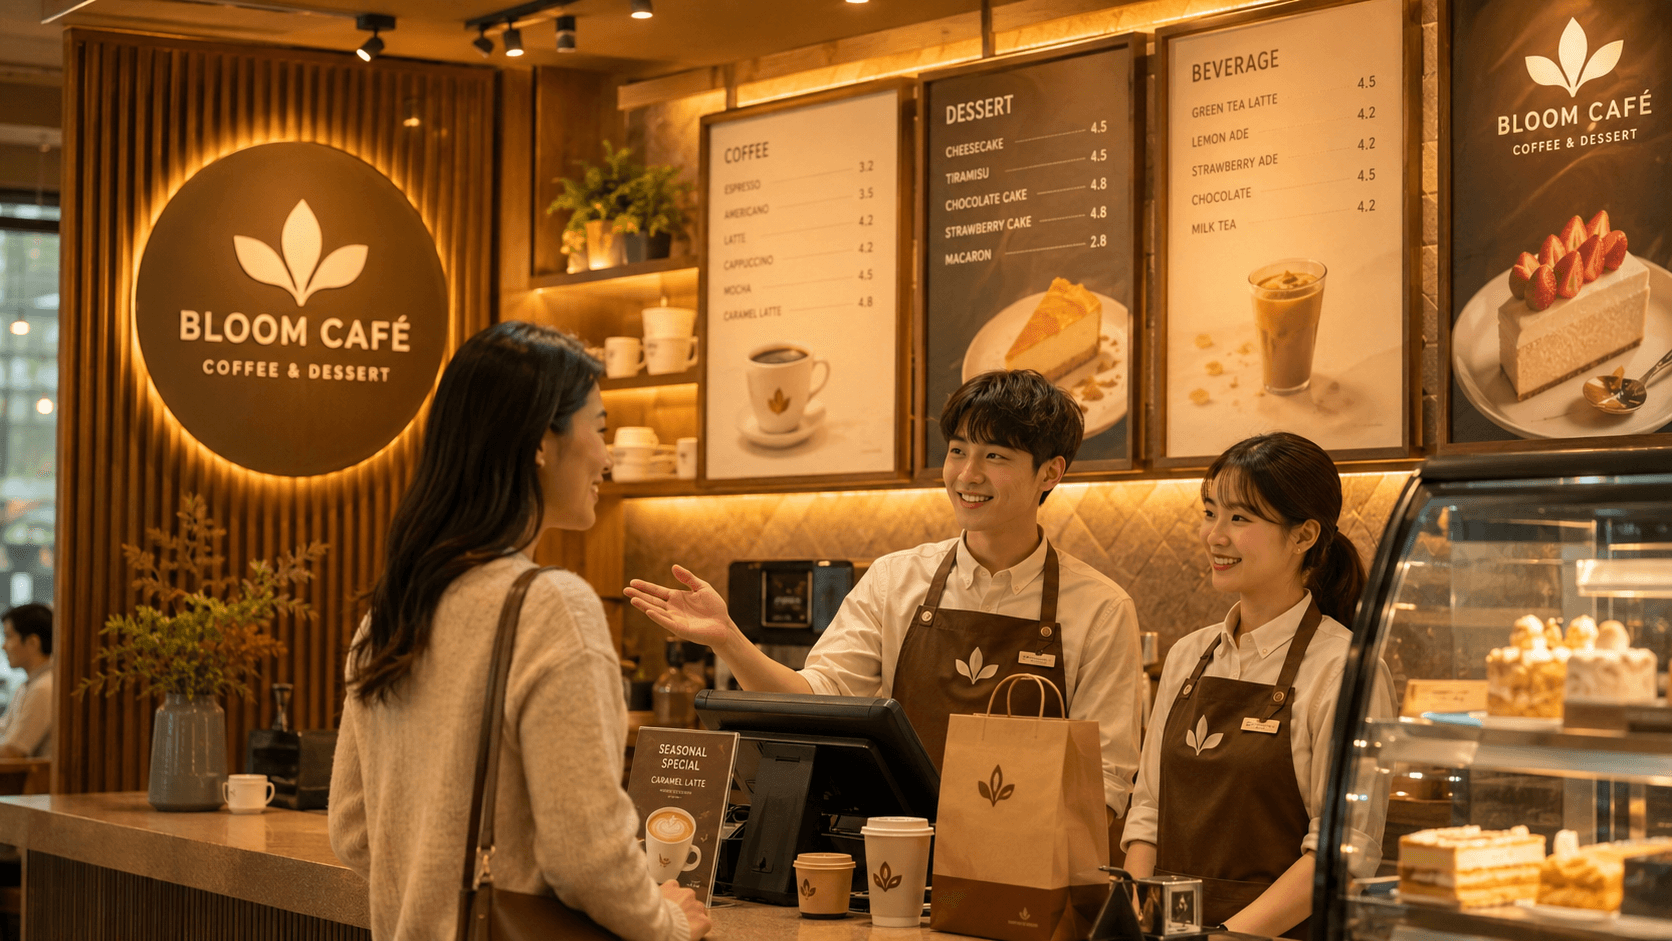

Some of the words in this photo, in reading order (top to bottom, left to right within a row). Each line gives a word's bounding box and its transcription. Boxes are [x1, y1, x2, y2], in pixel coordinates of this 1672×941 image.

[1192, 48, 1280, 82] BEVERAGE
[946, 94, 1014, 125] DESSERT
[1192, 103, 1224, 118] GREEN
[1227, 100, 1245, 112] TEA
[1248, 93, 1278, 109] LATTE
[1357, 75, 1376, 89] 4.5
[1498, 104, 1578, 136] BLOOM
[1588, 89, 1652, 122] CAFÉ
[945, 138, 1004, 158] CHEESECAKE
[1090, 120, 1107, 134] 4.5
[1192, 132, 1226, 148] LEMON
[1229, 128, 1249, 141] ADE
[1357, 106, 1376, 120] 4.2
[1512, 139, 1560, 156] COFFEE
[1566, 137, 1575, 148] &
[1580, 128, 1638, 146] DESSERT
[724, 141, 769, 164] COFFEE
[946, 167, 990, 185] TIRAMISU
[1090, 149, 1107, 162] 4.5
[1192, 157, 1256, 177] STRAWBERRY
[1258, 153, 1278, 166] ADE
[1357, 137, 1376, 150] 4.2
[724, 179, 761, 195] ESPRESSO
[859, 160, 874, 172] 3.2
[1191, 186, 1252, 206] CHOCOLATE
[1357, 168, 1376, 182] 4.5
[724, 204, 769, 220] AMERICANO
[859, 187, 874, 200] 3.5
[945, 193, 1000, 212] CHOCOLATE
[1002, 188, 1028, 203] CAKE
[1090, 177, 1107, 191] 4.8
[724, 233, 746, 245] LATTE
[858, 214, 874, 226] 4.2
[945, 219, 1006, 239] STRAWBERRY
[1006, 215, 1032, 230] CAKE
[1090, 205, 1107, 219] 4.8
[1192, 221, 1215, 235] MILK
[1218, 219, 1237, 232] TEA
[1357, 199, 1376, 212] 4.2
[724, 255, 774, 271] CAPPUCCINO
[858, 242, 874, 253] 4.2
[945, 249, 992, 266] MACARON
[1090, 234, 1107, 248] 2.8
[724, 284, 752, 296] MOCHA
[858, 269, 873, 280] 4.5
[723, 308, 757, 321] CARAMEL
[759, 305, 782, 318] LATTE
[858, 296, 873, 307] 4.8
[179, 309, 308, 347] BLOOM
[320, 314, 411, 352] CAFÉ
[202, 359, 279, 378] COFFEE
[288, 362, 300, 379] &
[308, 363, 391, 382] DESSERT
[659, 743, 707, 757] SEASONAL
[661, 758, 700, 771] SPECIAL
[651, 776, 682, 786] CARAMEL
[684, 779, 706, 787] LATTE
